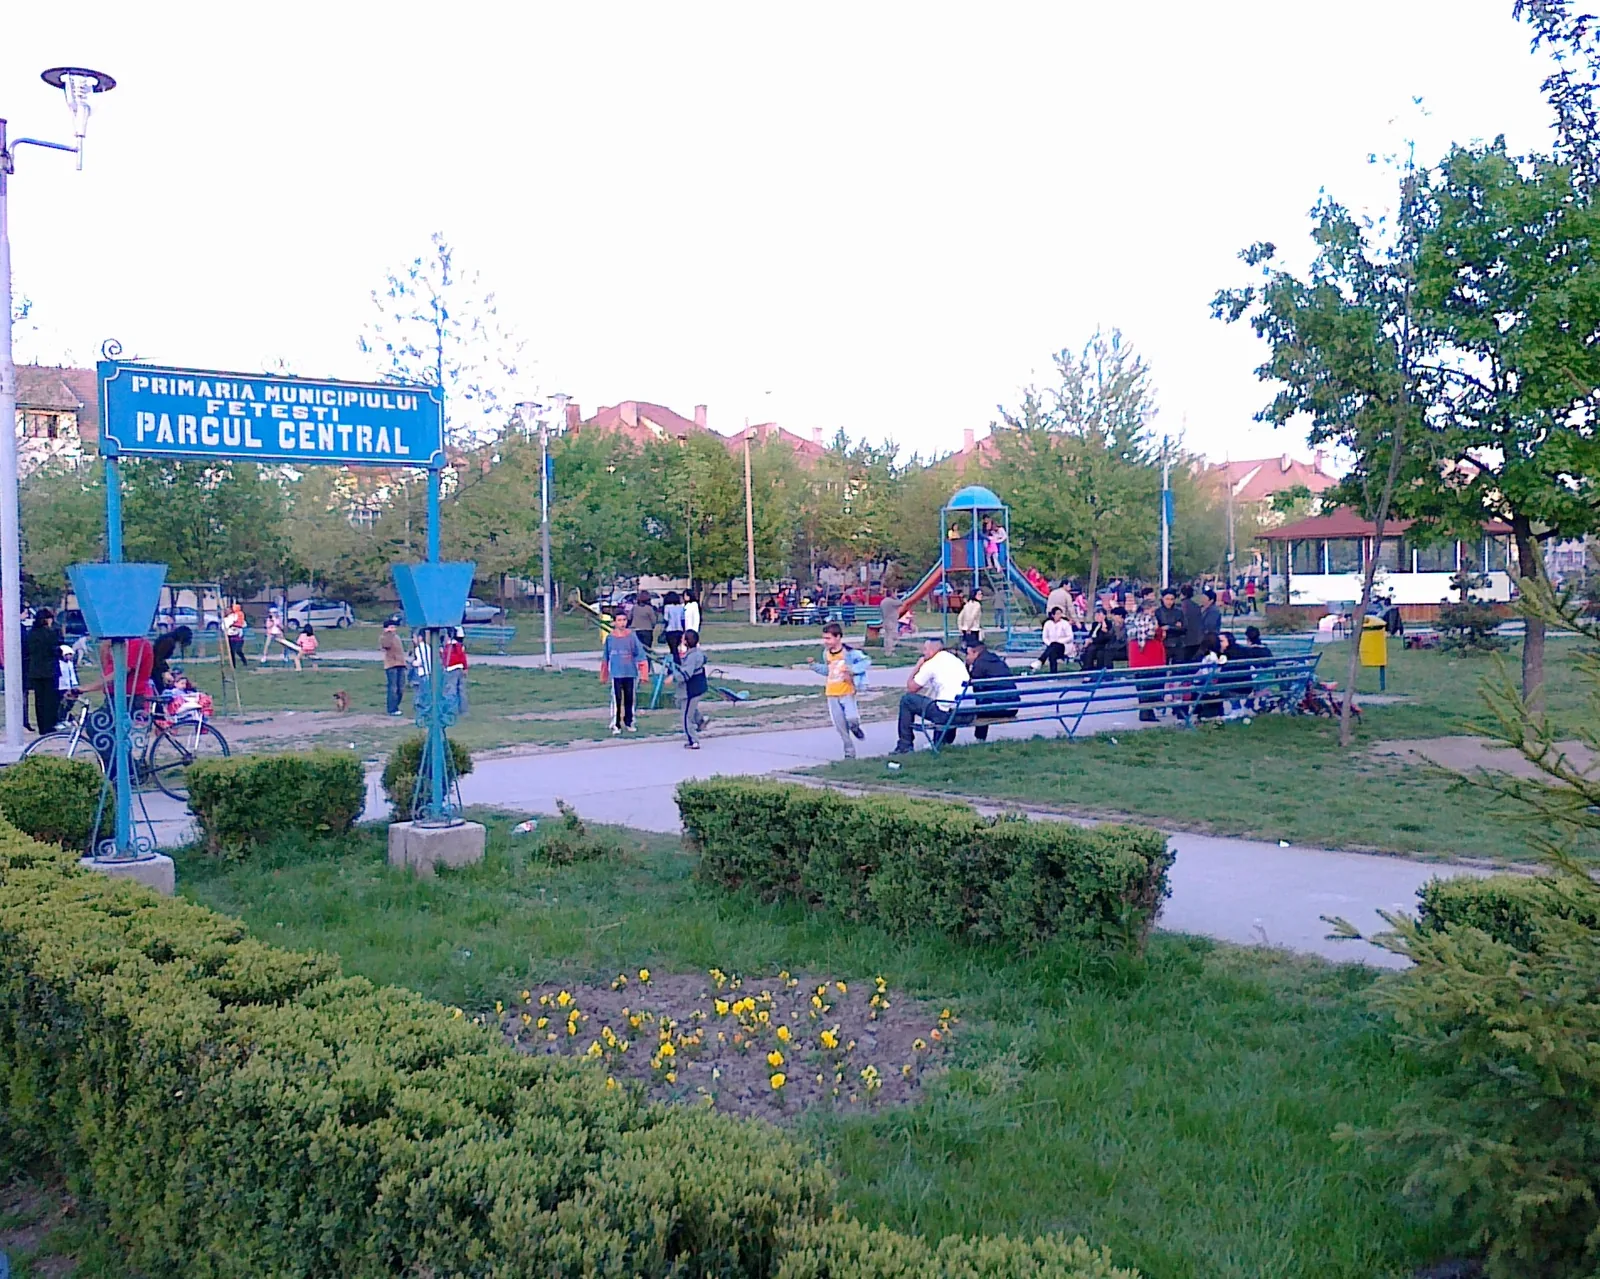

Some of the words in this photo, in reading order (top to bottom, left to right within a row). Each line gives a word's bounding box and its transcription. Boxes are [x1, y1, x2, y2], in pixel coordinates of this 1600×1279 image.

[132, 376, 255, 399] PRIMARIA
[265, 386, 418, 411] MUNICIPIULUI
[207, 400, 339, 422] FETESTI
[136, 412, 262, 447] PARCUL
[278, 421, 410, 454] CENTRAL
